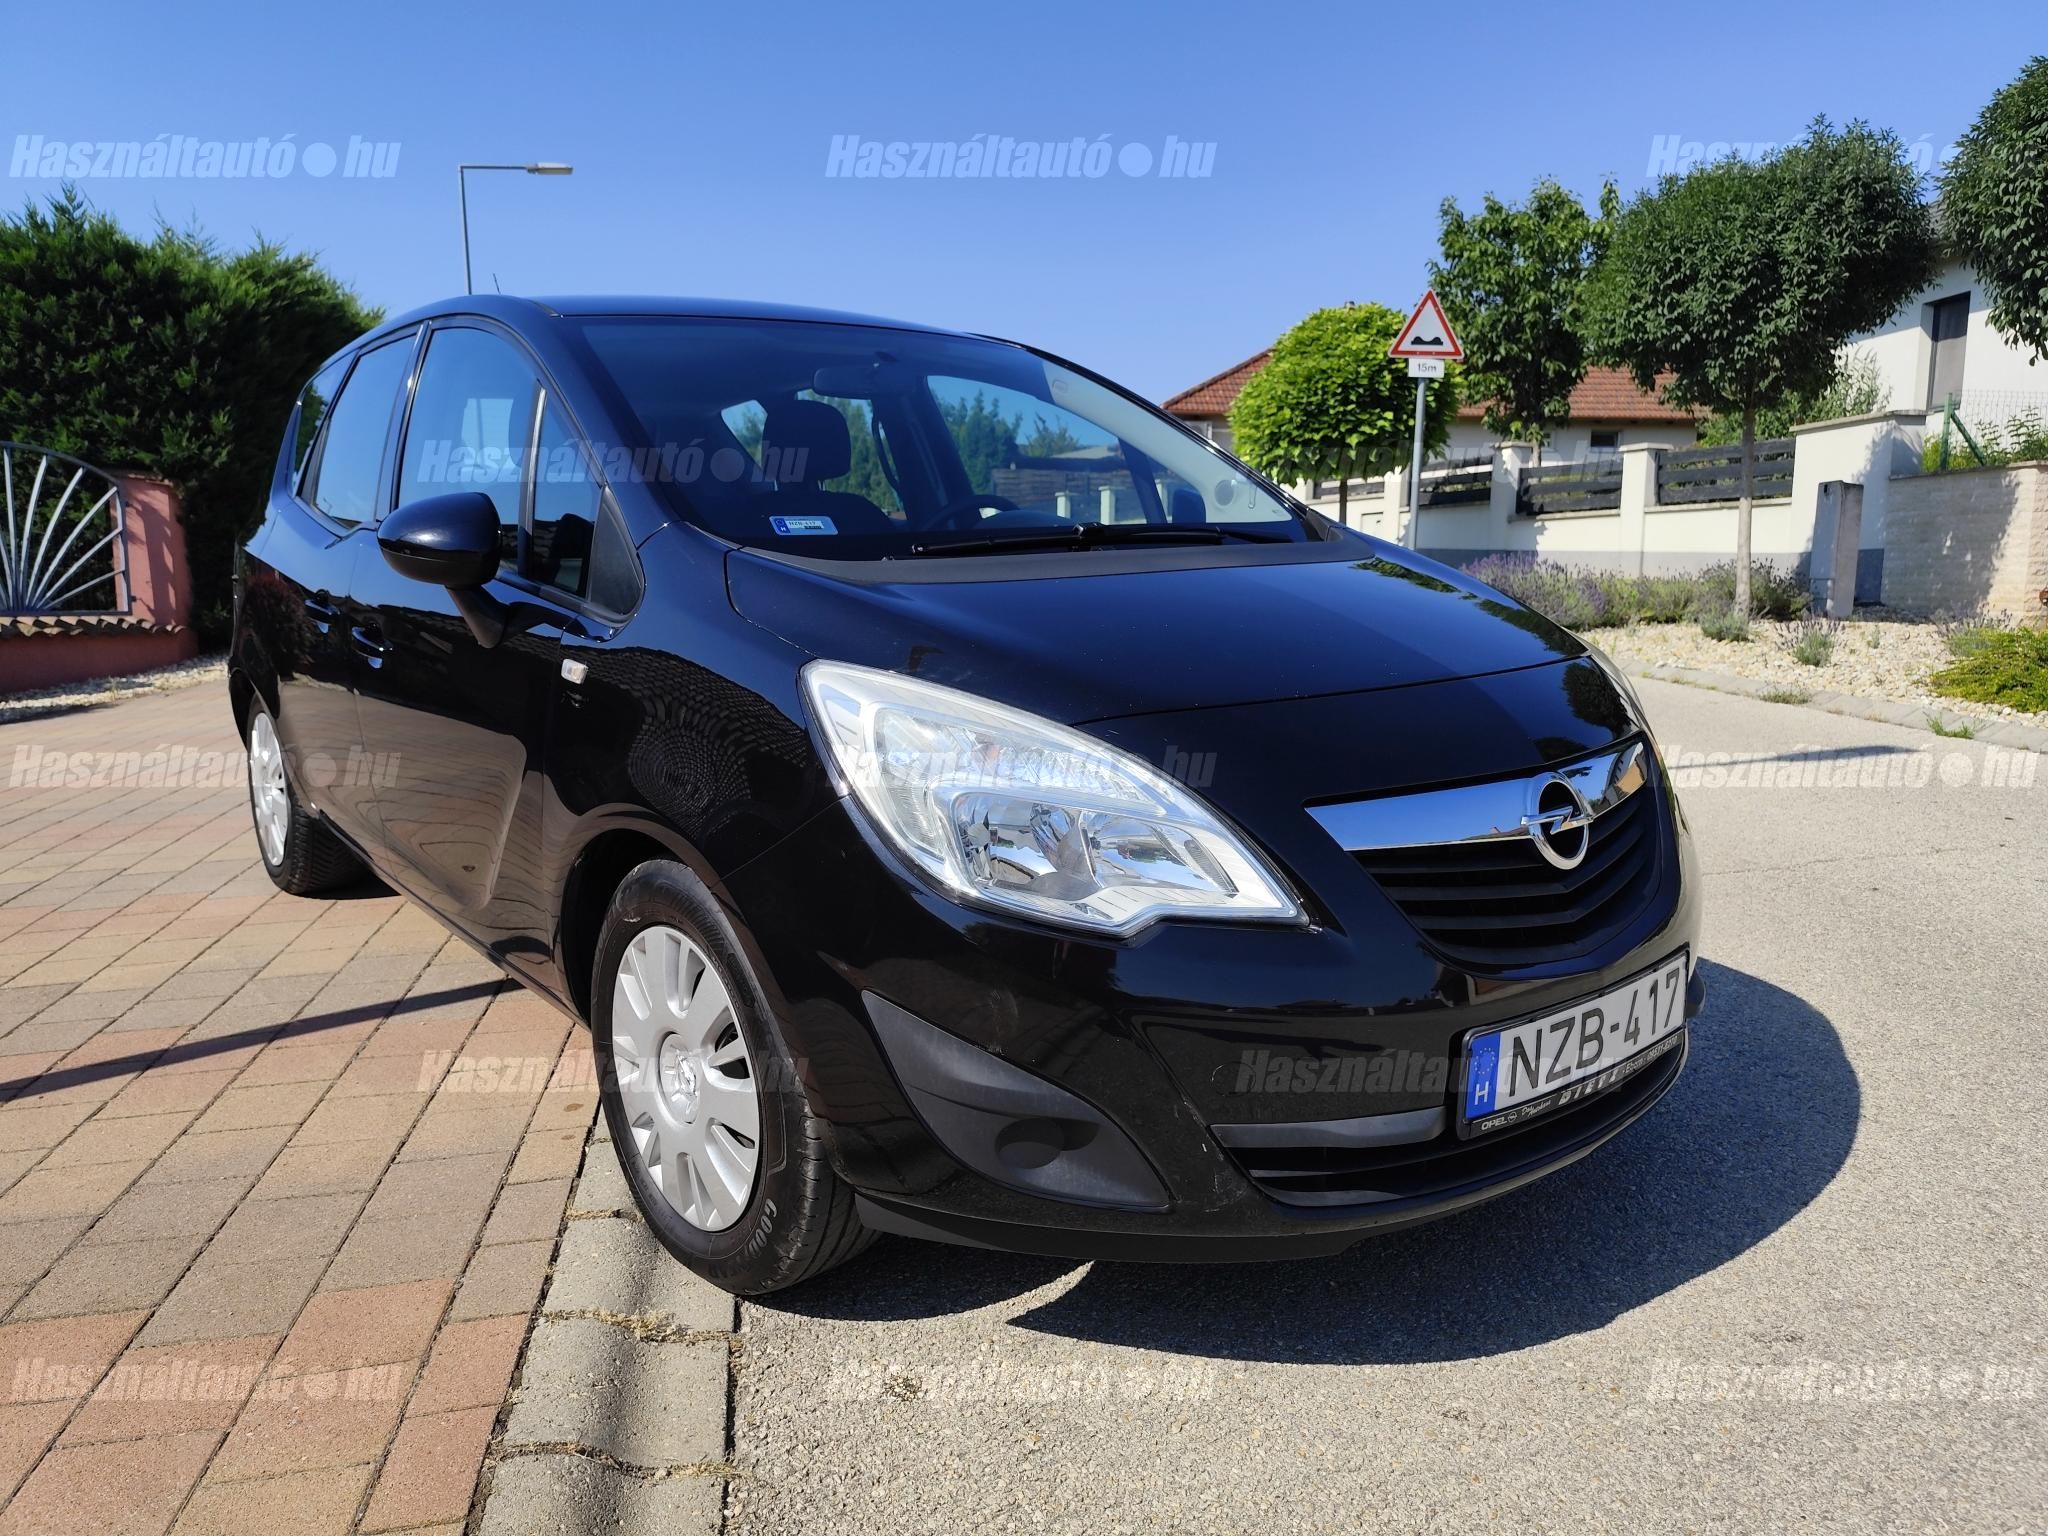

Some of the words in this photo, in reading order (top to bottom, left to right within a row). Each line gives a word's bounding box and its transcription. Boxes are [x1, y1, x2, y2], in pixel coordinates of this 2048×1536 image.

[1417, 363, 1437, 373] 15m
[1474, 1081, 1489, 1106] H
[1508, 968, 1680, 1097] NZB-417
[1481, 1116, 1508, 1131] OPEL
